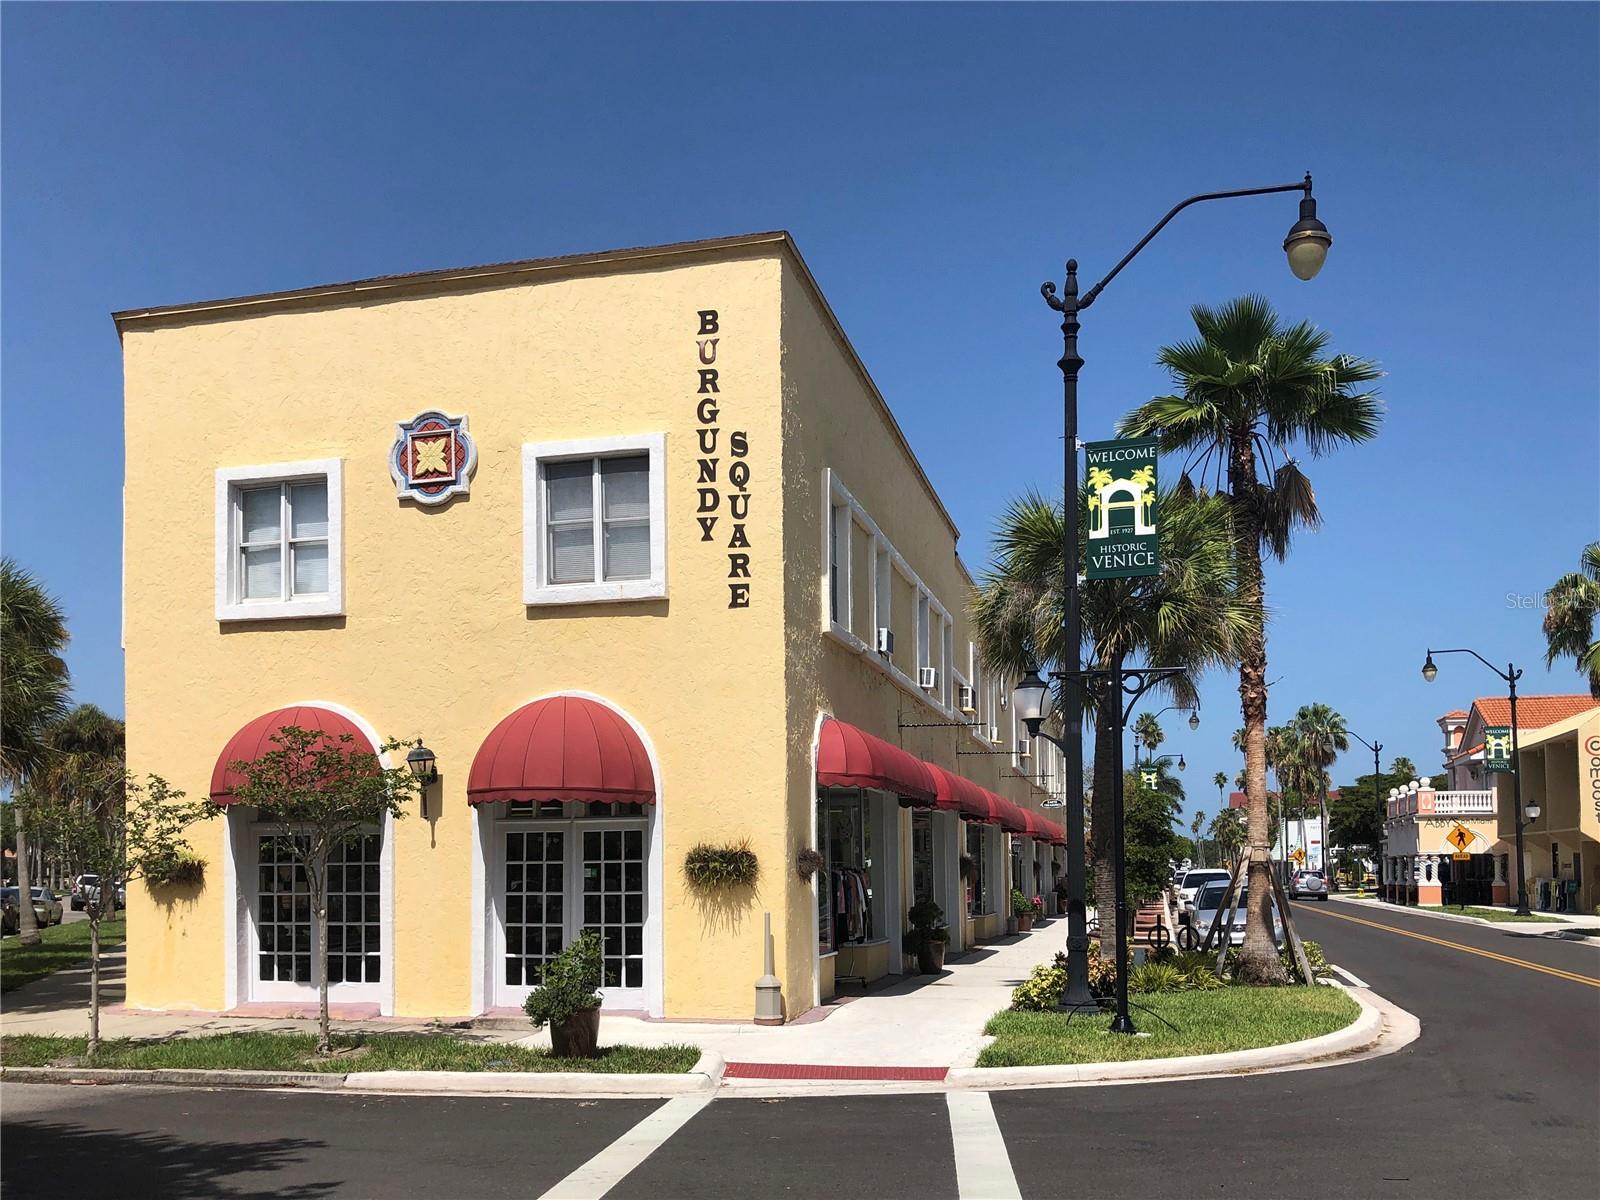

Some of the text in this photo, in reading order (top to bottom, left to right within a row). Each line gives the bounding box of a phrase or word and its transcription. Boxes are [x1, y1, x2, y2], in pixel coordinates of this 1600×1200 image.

[697, 309, 720, 541] BURGUNDY
[1088, 447, 1156, 464] WELCOME
[728, 431, 752, 609] SQUARE
[1100, 542, 1147, 554] HISTORIC
[1092, 552, 1155, 569] VENICE
